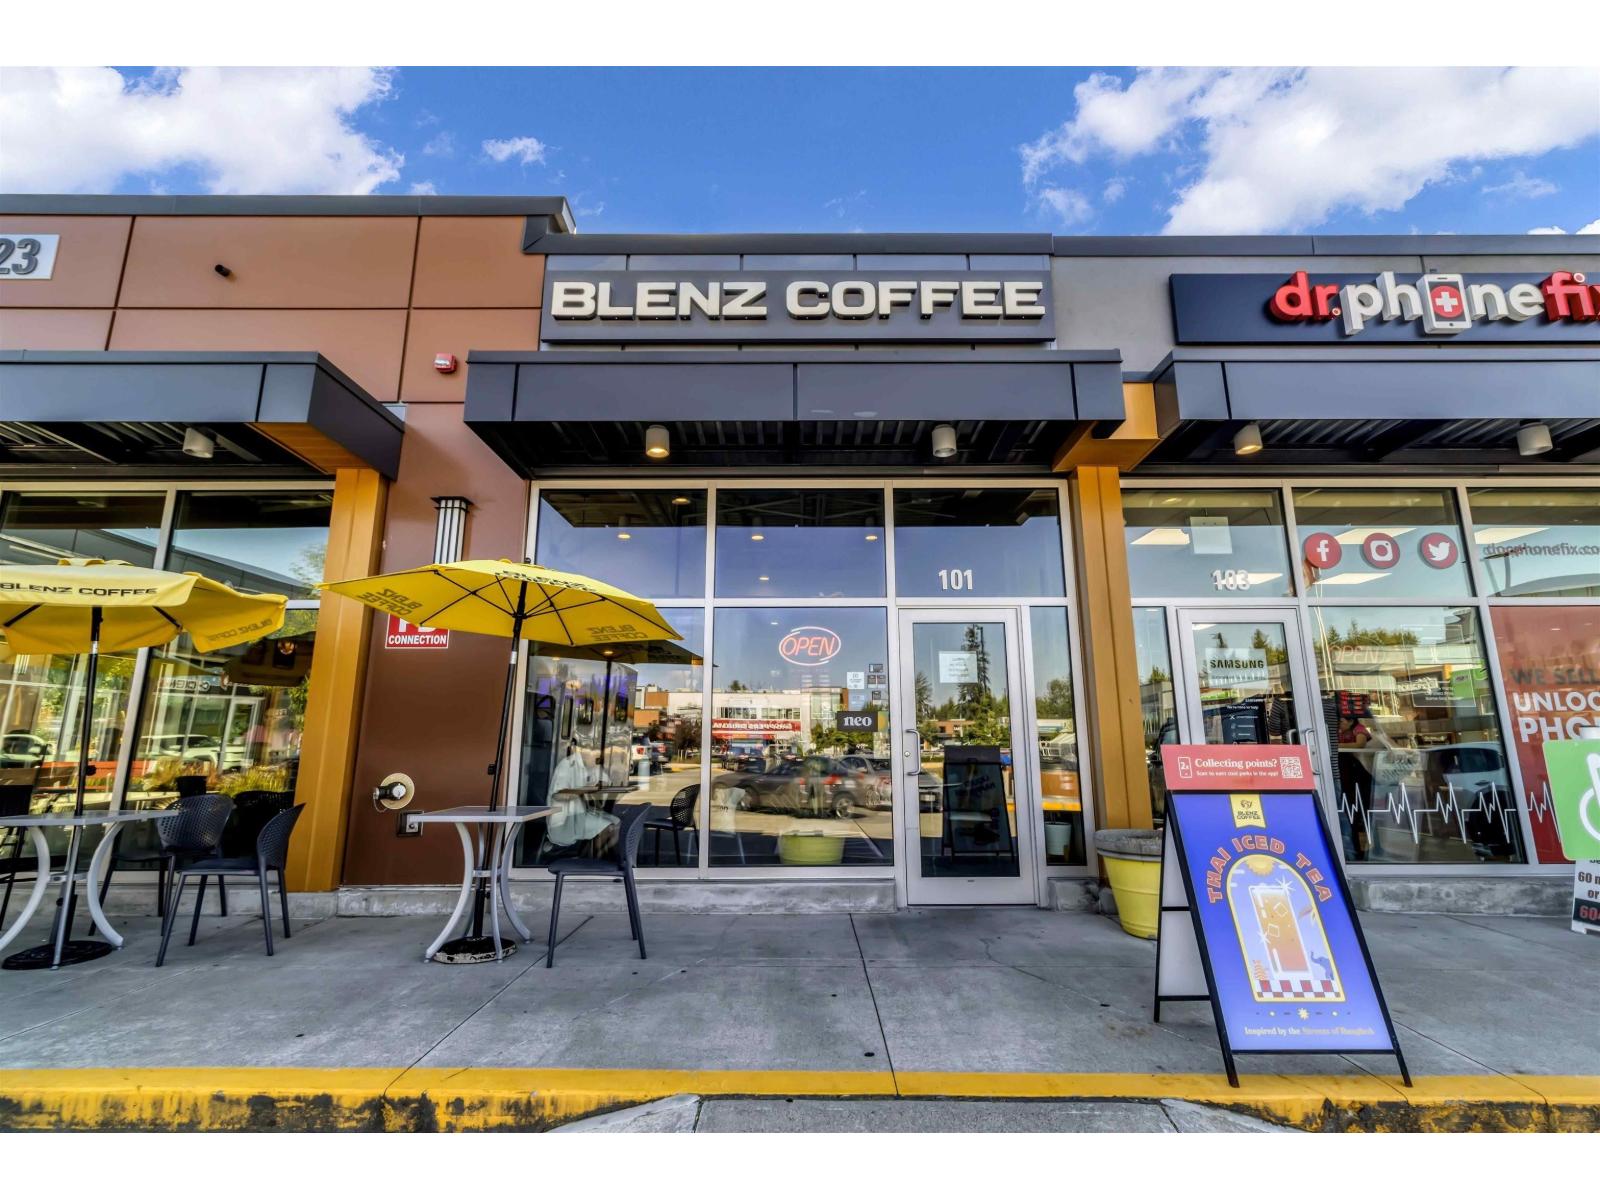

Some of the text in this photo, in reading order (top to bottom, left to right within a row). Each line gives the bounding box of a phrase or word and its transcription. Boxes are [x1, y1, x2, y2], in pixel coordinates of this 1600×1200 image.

[551, 281, 1046, 320] BLENZ COFFEE
[938, 569, 974, 590] 101
[1211, 569, 1250, 590] 103
[0, 582, 158, 597] BLENZ COFFEE
[388, 634, 447, 645] CONNECTION
[782, 637, 835, 656] OPEN
[1210, 659, 1264, 669] SAMSUNG
[1508, 669, 1546, 685] WE
[843, 716, 873, 727] neo
[1518, 716, 1600, 742] PHO
[1195, 758, 1244, 769] Collecting
[1245, 758, 1278, 769] points?
[1206, 835, 1332, 903] THAI ICED TEA
[1578, 871, 1593, 883] 60
[1579, 905, 1600, 920] 60
[1244, 1026, 1277, 1036] Inspired
[1278, 1026, 1287, 1036] by
[1288, 1026, 1300, 1035] the
